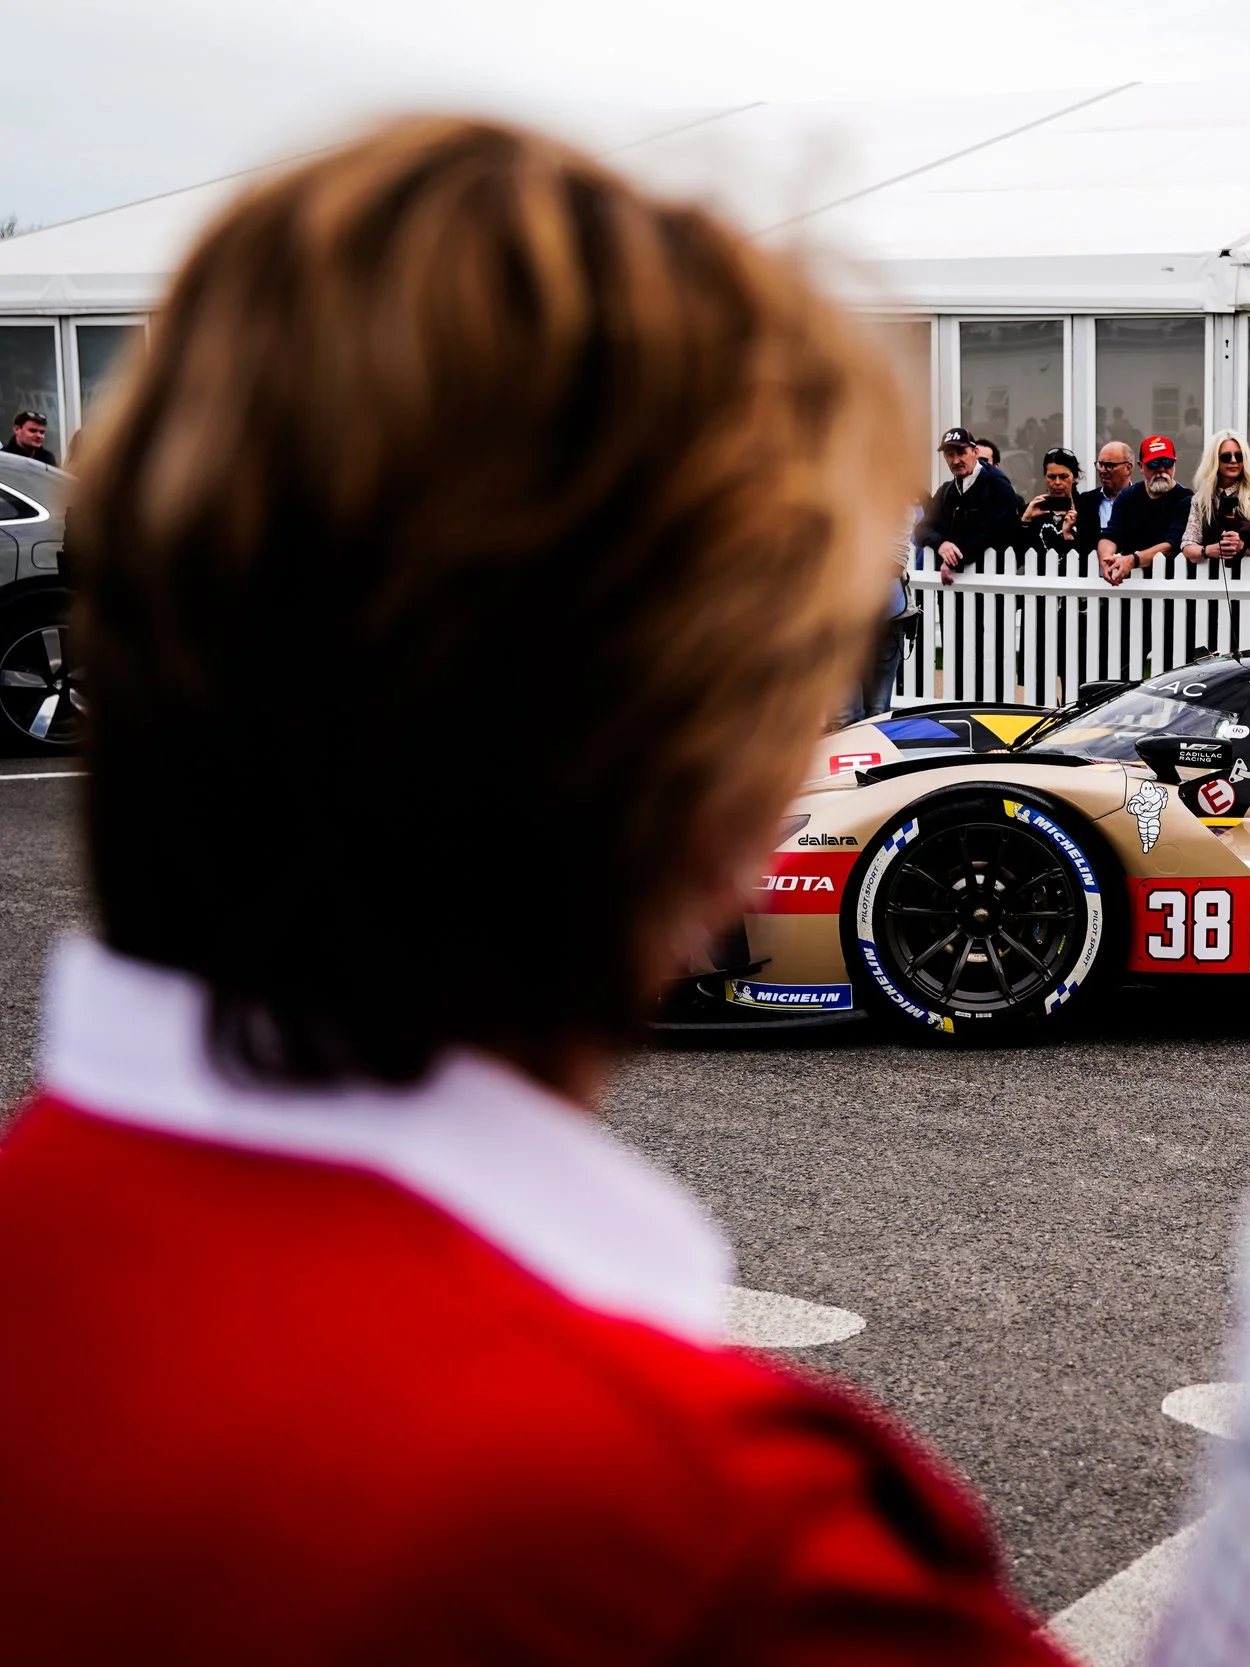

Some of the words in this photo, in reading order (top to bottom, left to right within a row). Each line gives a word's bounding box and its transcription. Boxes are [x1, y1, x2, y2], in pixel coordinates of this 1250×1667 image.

[1179, 751, 1223, 759] CADILLAC
[1201, 780, 1231, 814] E
[797, 833, 859, 846] dallara
[1033, 816, 1095, 886] MICHELIN
[865, 866, 879, 896] SPORT
[861, 896, 871, 924] PILOT
[1147, 889, 1232, 961] 38
[1083, 937, 1096, 967] SPORT
[756, 991, 841, 1003] MICHELIN
[863, 947, 925, 1018] MICHELIN
